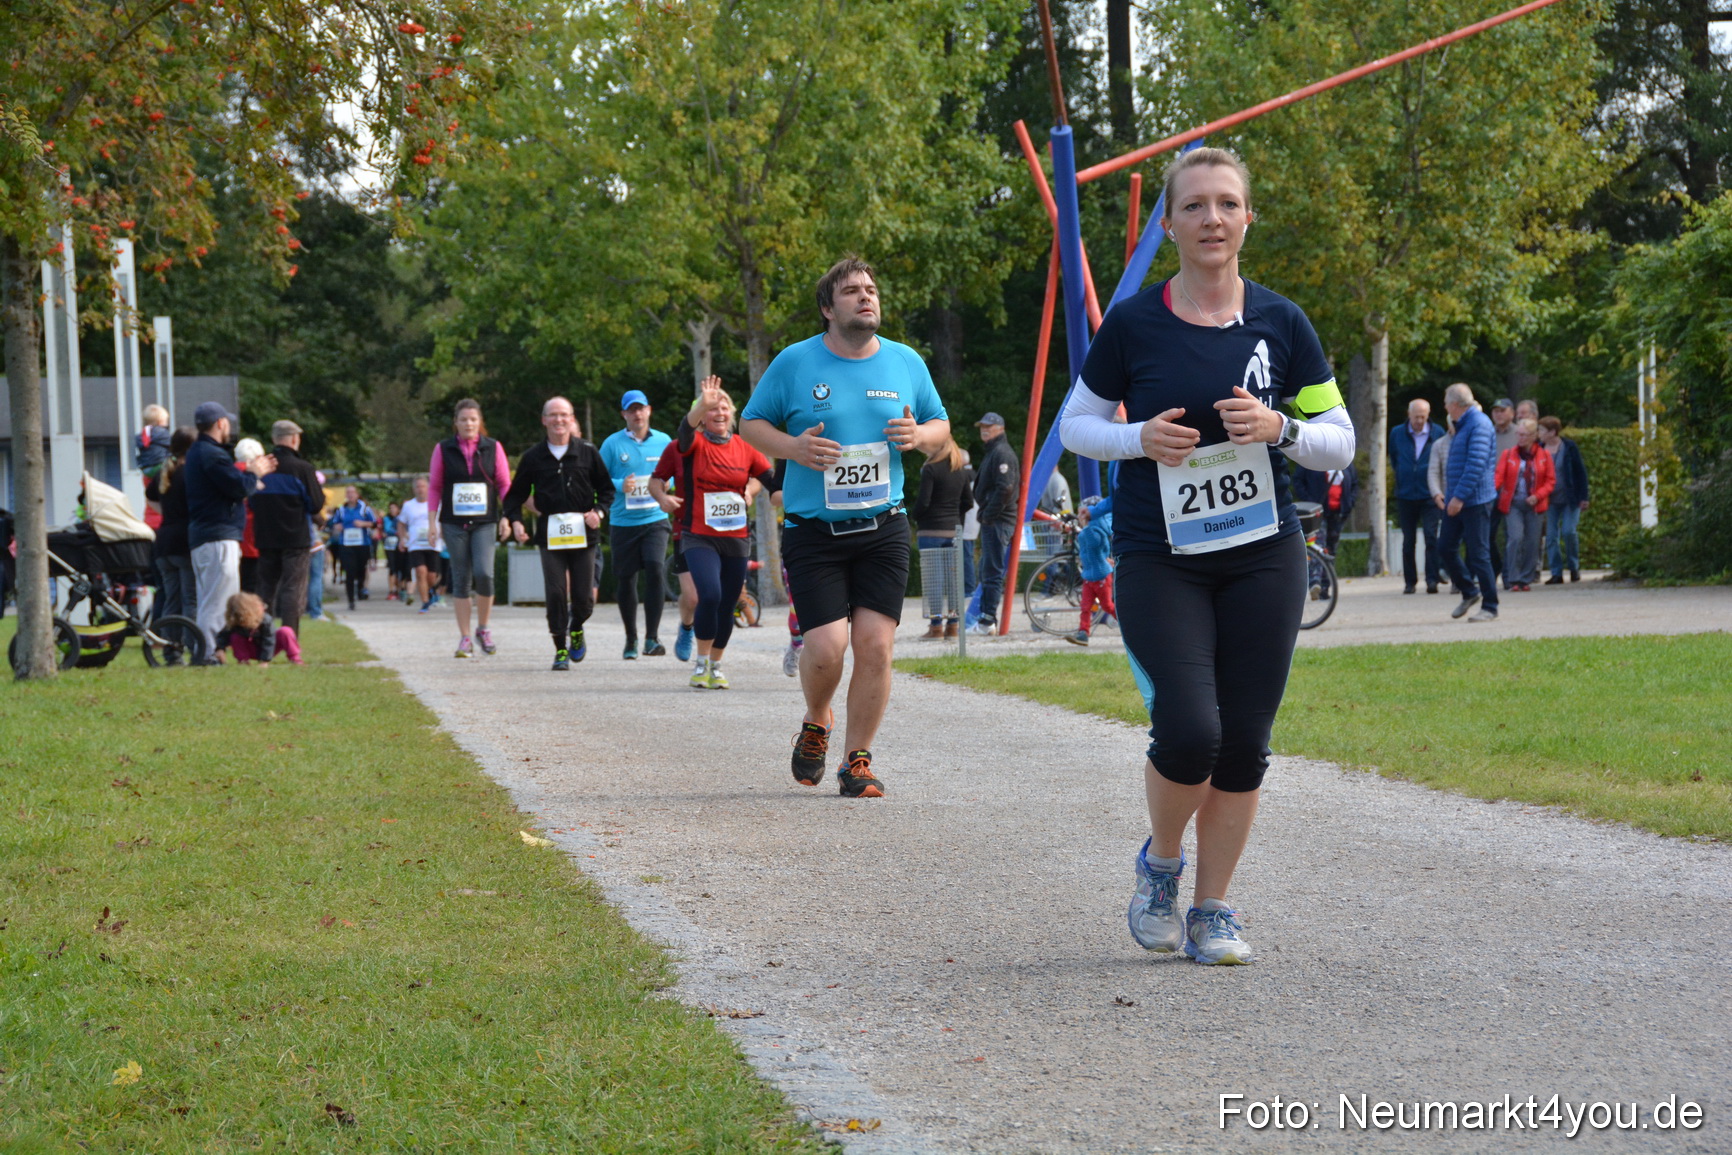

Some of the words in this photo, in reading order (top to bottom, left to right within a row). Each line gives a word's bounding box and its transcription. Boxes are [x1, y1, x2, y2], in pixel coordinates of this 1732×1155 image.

[866, 389, 899, 399] BOCK
[1200, 449, 1236, 467] BOCK
[834, 462, 880, 485] 2521
[631, 485, 649, 496] 212
[847, 490, 873, 499] Markus
[1178, 469, 1258, 515] 2183
[457, 493, 481, 503] 2606
[711, 503, 740, 517] 2529
[559, 524, 573, 535] 85
[1203, 516, 1245, 534] Daniela
